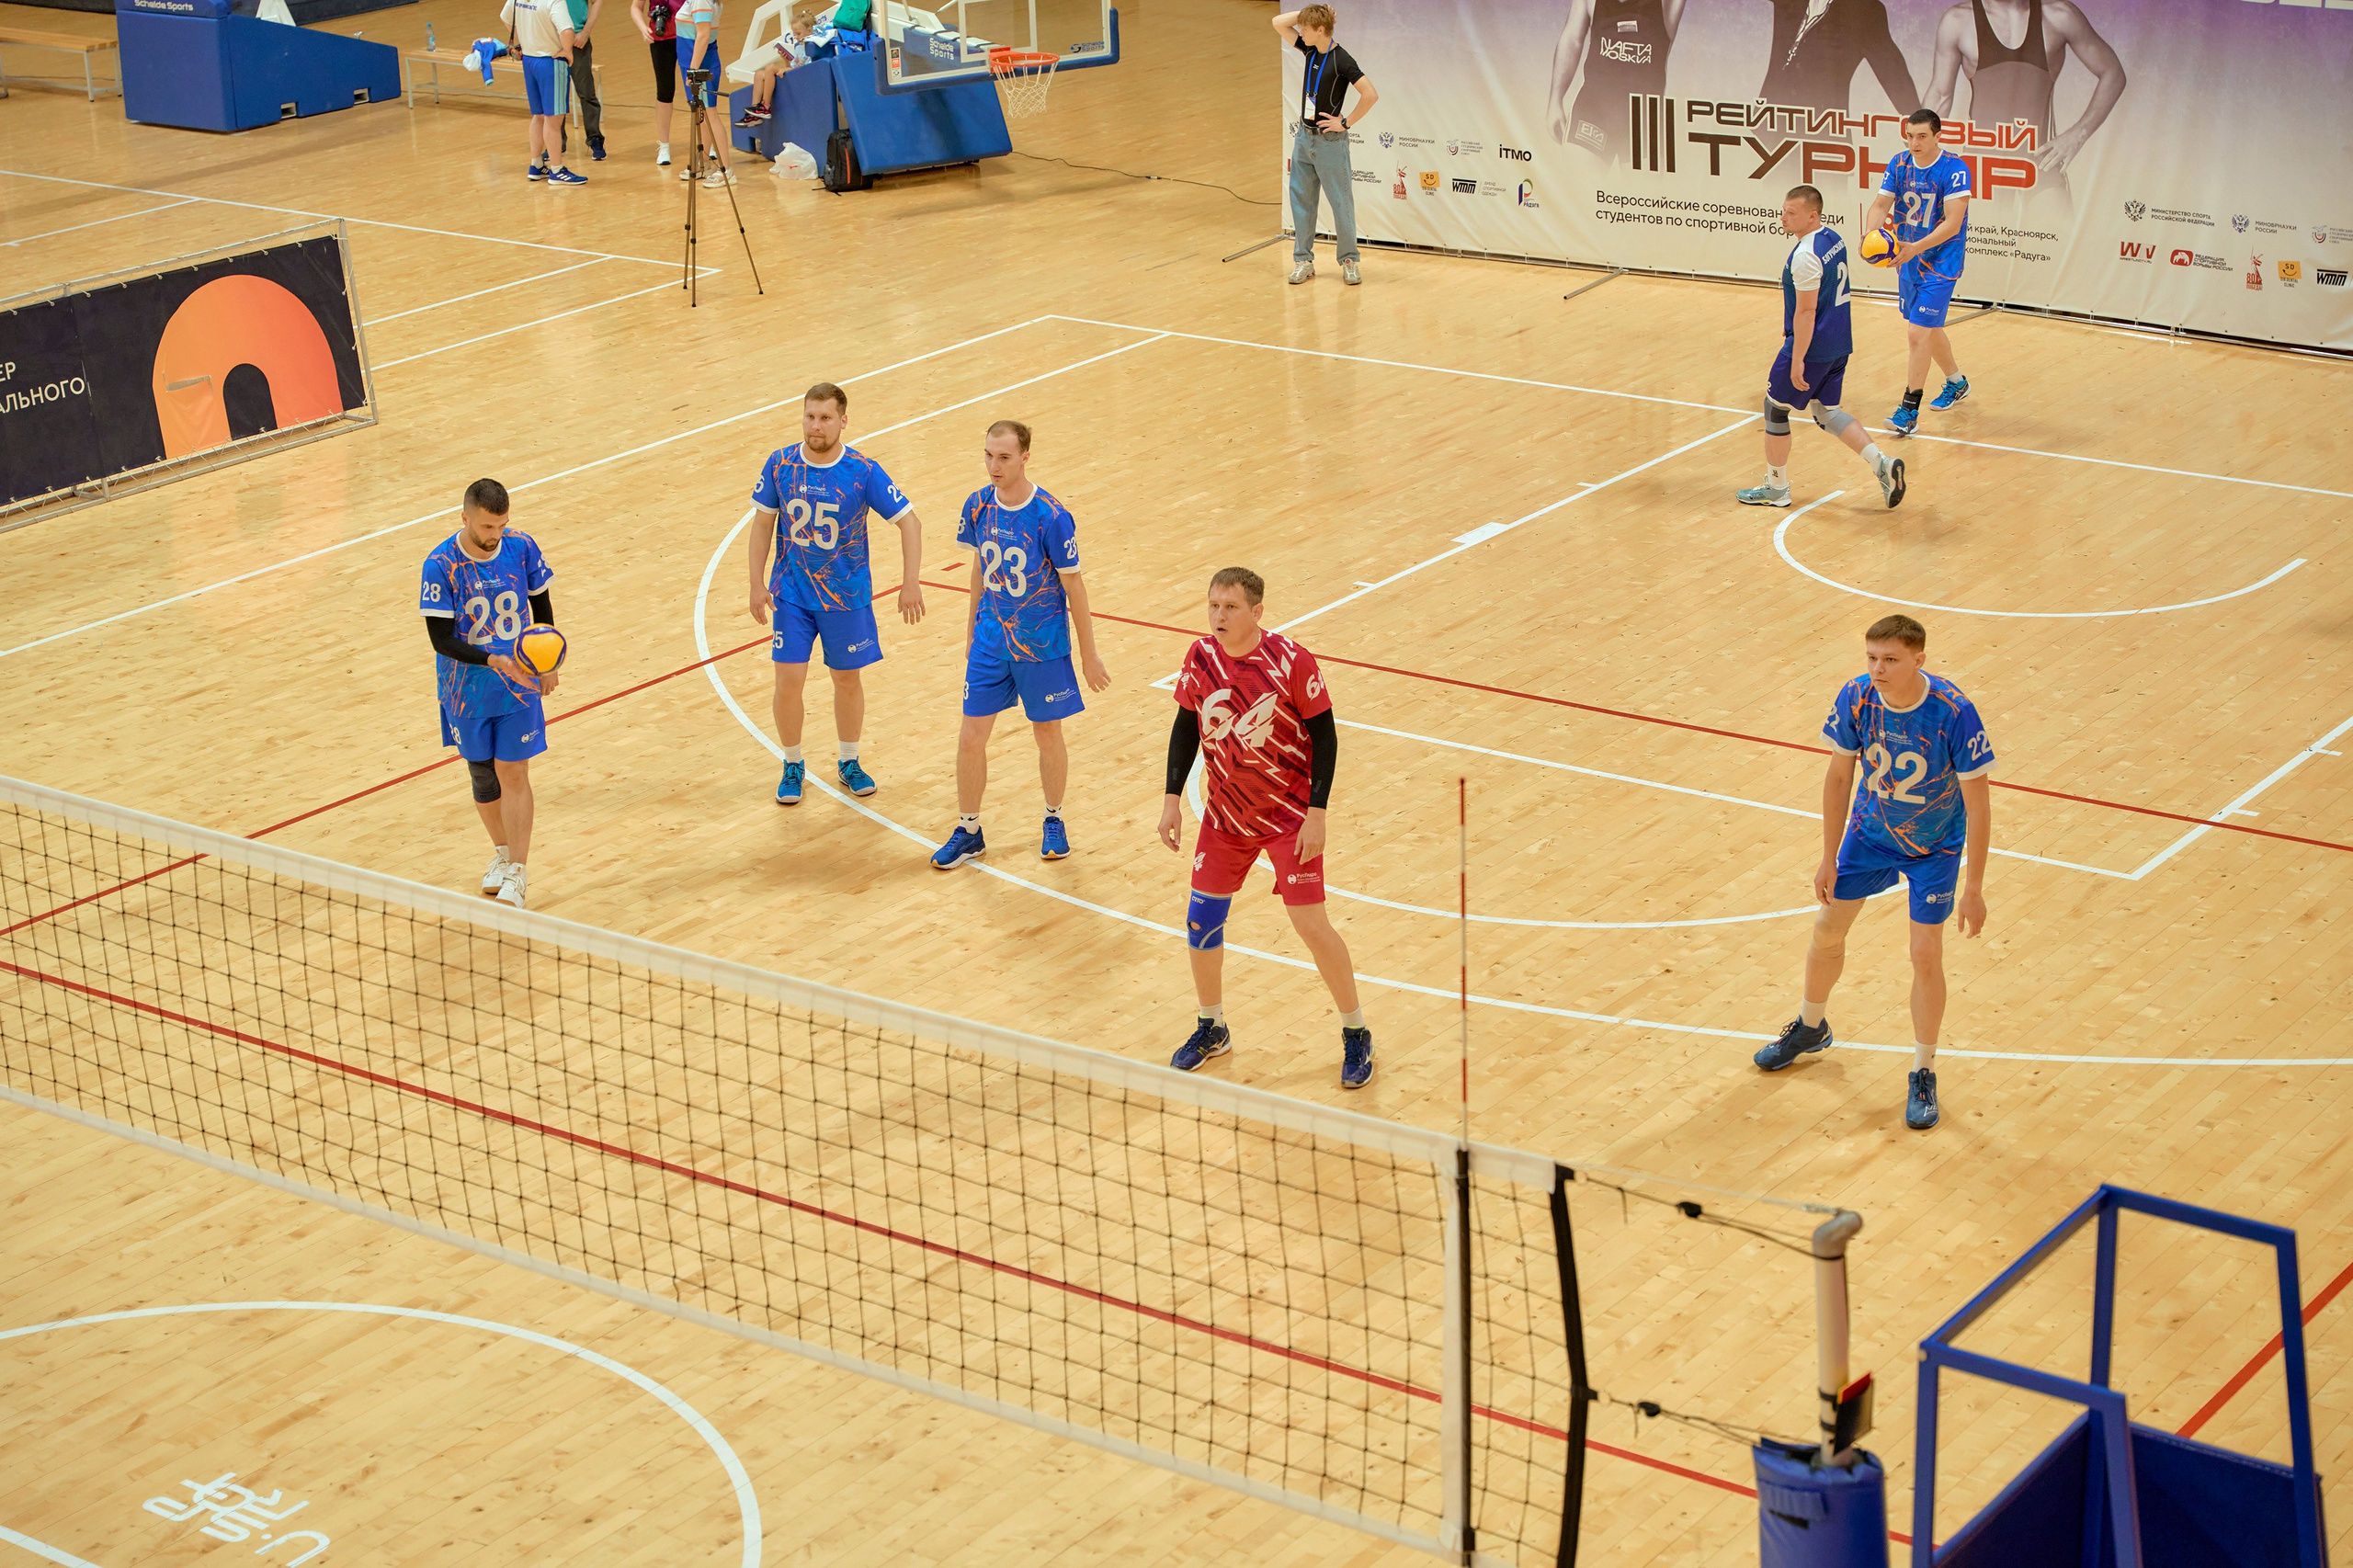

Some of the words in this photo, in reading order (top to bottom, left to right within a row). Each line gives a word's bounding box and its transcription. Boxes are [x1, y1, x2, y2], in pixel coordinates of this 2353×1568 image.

[134, 0, 165, 9] Schelde
[166, 2, 193, 12] Sports
[929, 38, 954, 52] Schelde
[929, 47, 955, 61] Sports
[1600, 37, 1652, 56] NAFTA
[1688, 98, 2036, 153] РЕЙТИНГВЫЙ
[1399, 136, 1436, 144] МИНОБРНАУКИ
[1951, 171, 1967, 188] 27
[1597, 190, 1700, 212] Всероссийские
[1821, 214, 1844, 225] еди
[1903, 190, 1937, 228] 27
[2151, 208, 2191, 217] МИНИСТЕРСТВО
[2192, 212, 2211, 221] СПОРТА
[1596, 210, 1663, 226] студентов
[1665, 216, 1682, 226] по
[1685, 218, 1766, 233] спортивной
[2151, 214, 2186, 222] РОССИЙСКОЙ
[2187, 219, 2215, 227] ФЕДЕРАЦИИ
[2255, 221, 2297, 231] МИНОБРНАУКИ
[1974, 225, 1999, 235] край,
[2001, 226, 2059, 242] Красноярск,
[2010, 249, 2051, 262] «Радуга»
[2194, 257, 2227, 267] СПОРТИВНОЙ
[786, 498, 840, 550] 25
[1063, 536, 1077, 560] 23
[981, 540, 1027, 597] 23
[422, 581, 441, 603] 28
[465, 590, 521, 645] 28
[1200, 688, 1279, 748] 64
[1967, 730, 1992, 761] 22
[1866, 743, 1928, 805] 22
